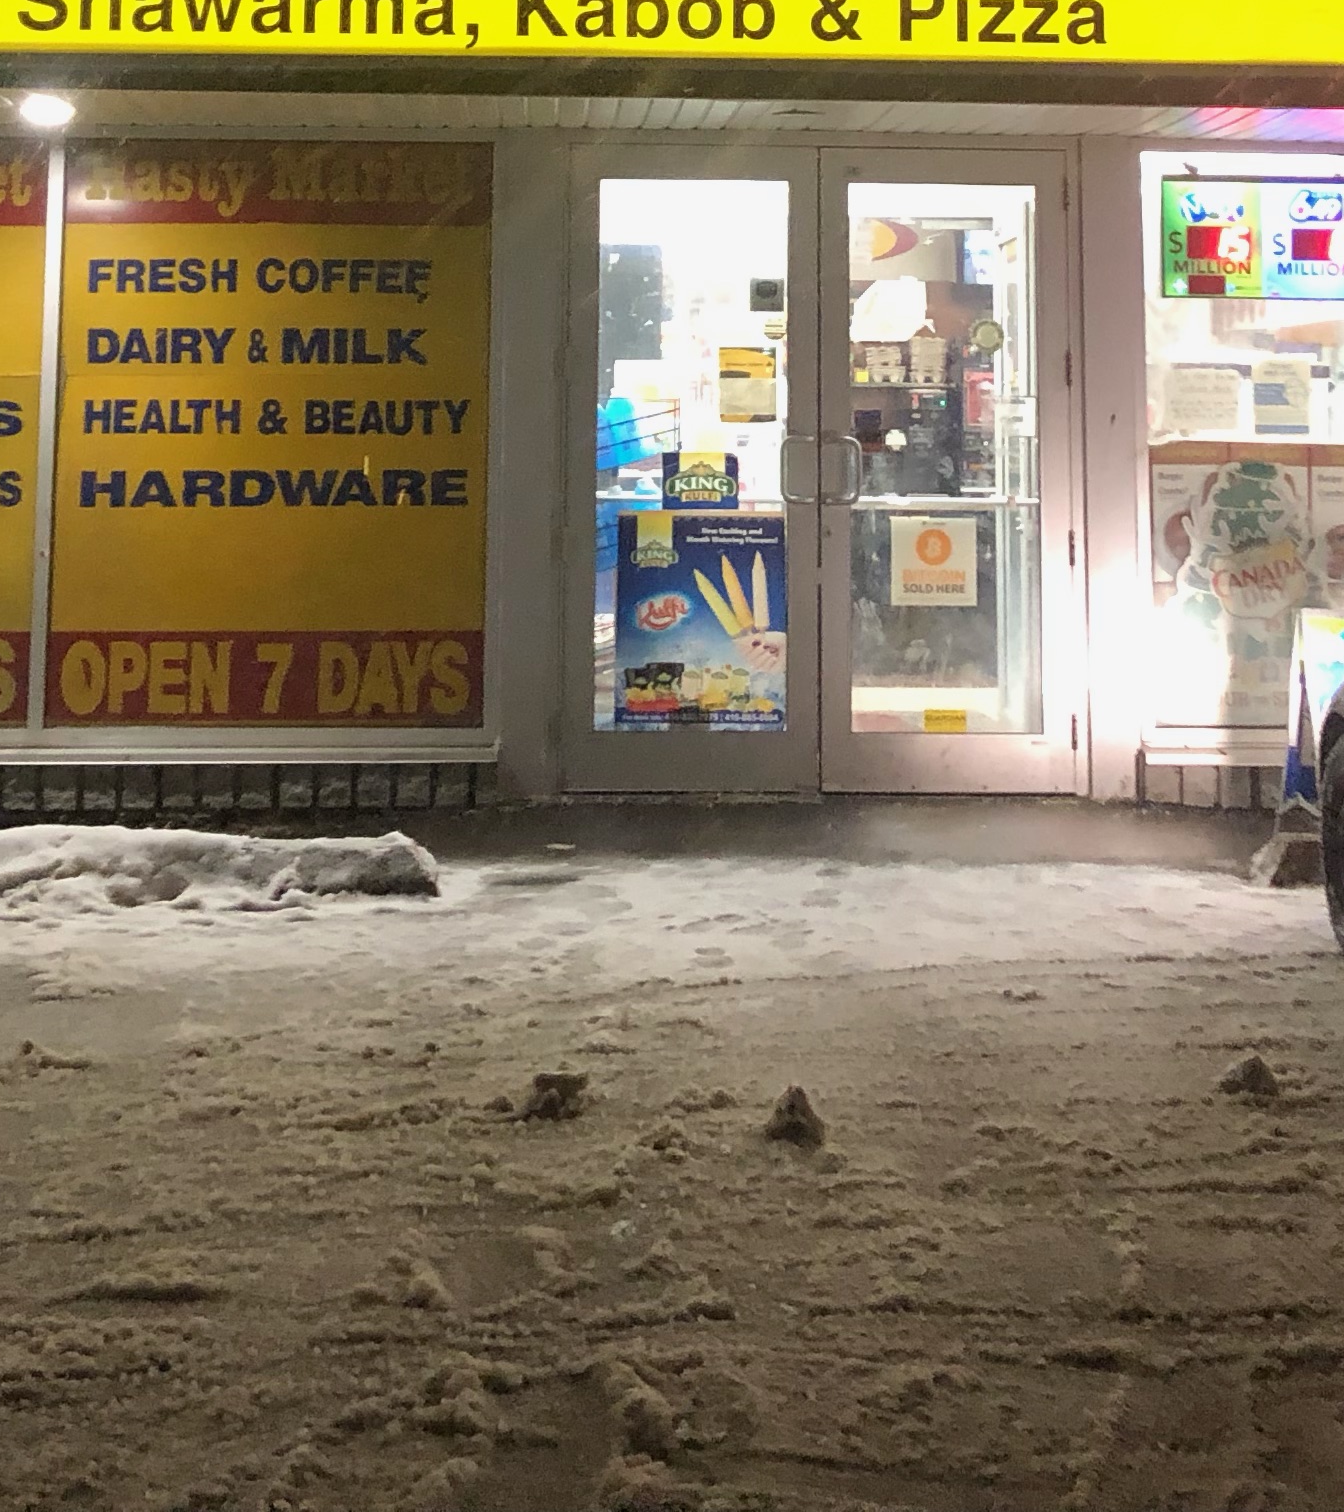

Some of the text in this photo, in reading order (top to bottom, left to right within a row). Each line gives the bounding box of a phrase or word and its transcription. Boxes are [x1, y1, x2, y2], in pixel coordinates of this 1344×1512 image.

[85, 146, 477, 216] Hasty Market
[88, 259, 238, 293] FRESH
[1173, 260, 1251, 275] MILLION
[87, 328, 427, 365] DAIRY & MILK
[83, 399, 471, 435] HEALTH & BEAUTY
[79, 469, 468, 508] HARDWARE
[674, 476, 729, 492] KING
[902, 583, 965, 594] SOLD HERE
[1212, 557, 1306, 598] CANADA
[59, 640, 470, 715] OPEN 7 DAYS
